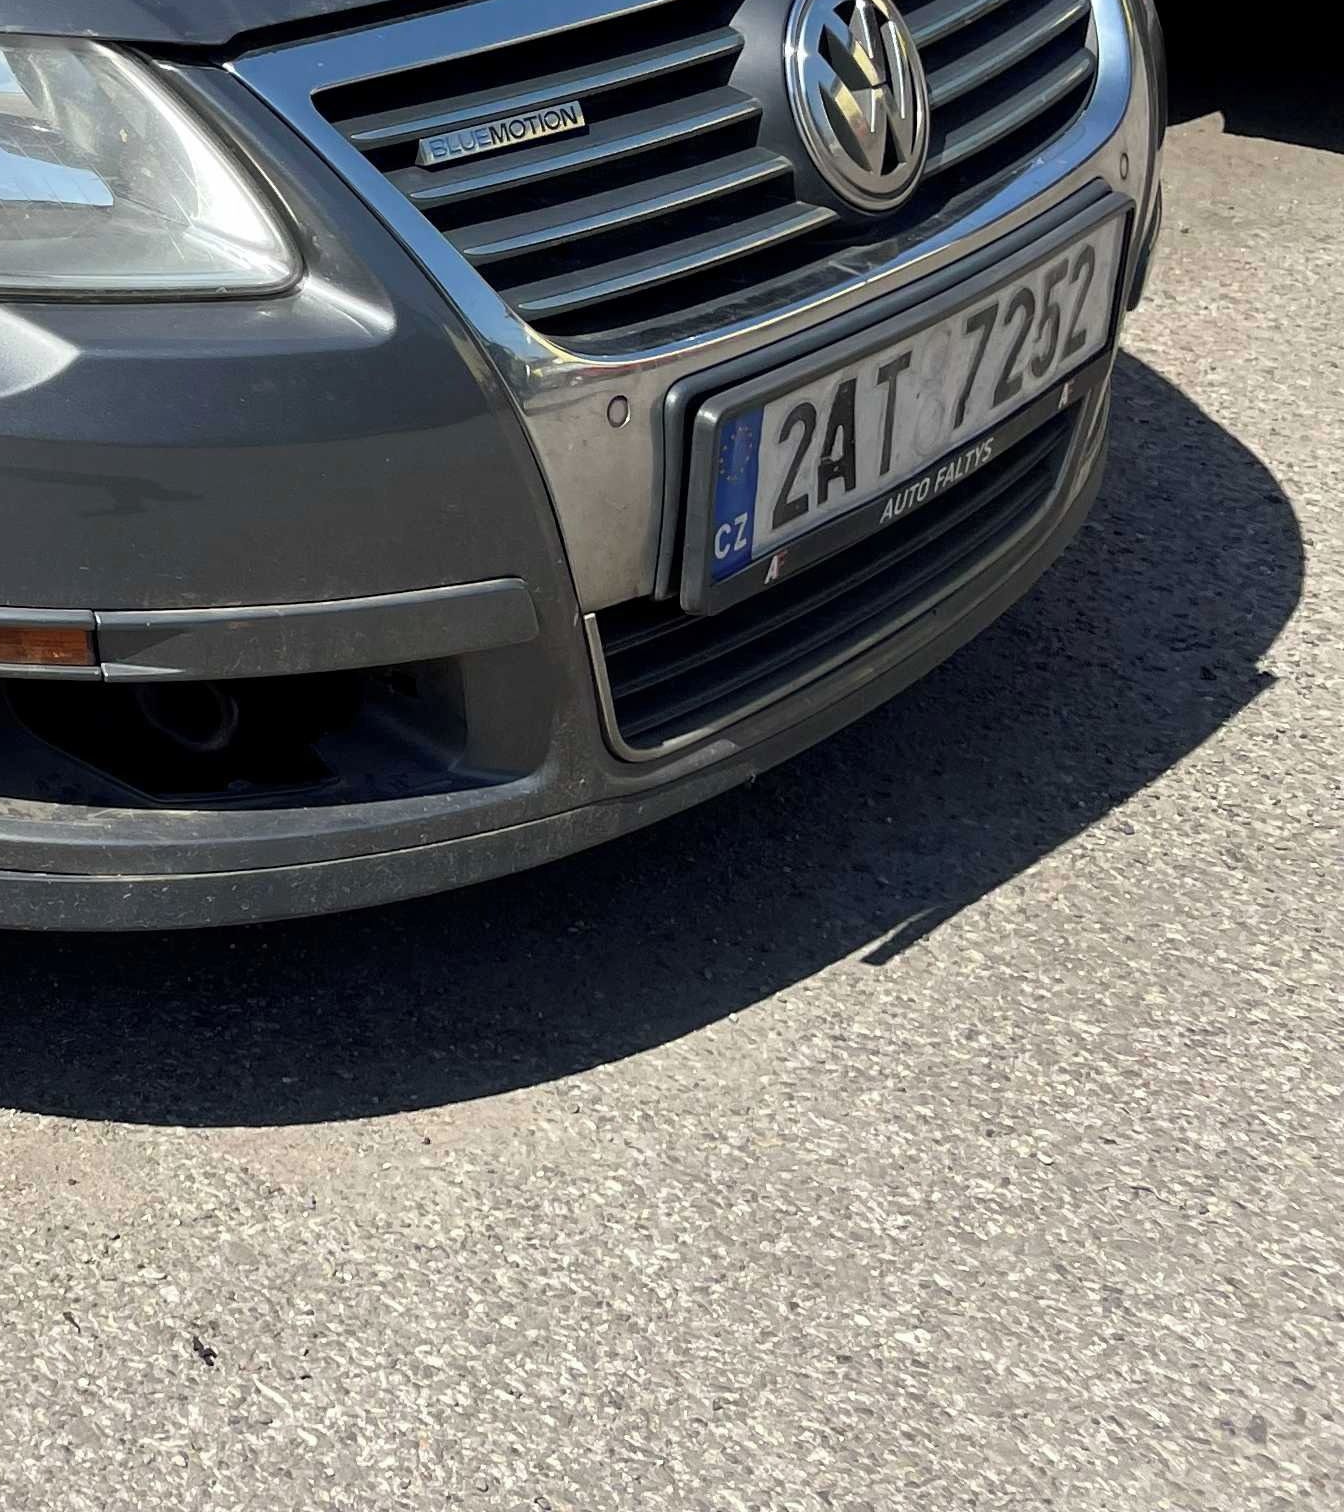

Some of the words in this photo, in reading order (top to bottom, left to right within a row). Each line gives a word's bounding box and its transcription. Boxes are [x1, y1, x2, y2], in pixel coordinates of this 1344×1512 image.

[428, 105, 578, 158] BLUEMOTION
[771, 352, 911, 531] 2AT
[953, 244, 1095, 429] 7252
[879, 477, 930, 524] AUTO
[934, 437, 994, 493] FALTYS
[715, 511, 748, 559] CZ
